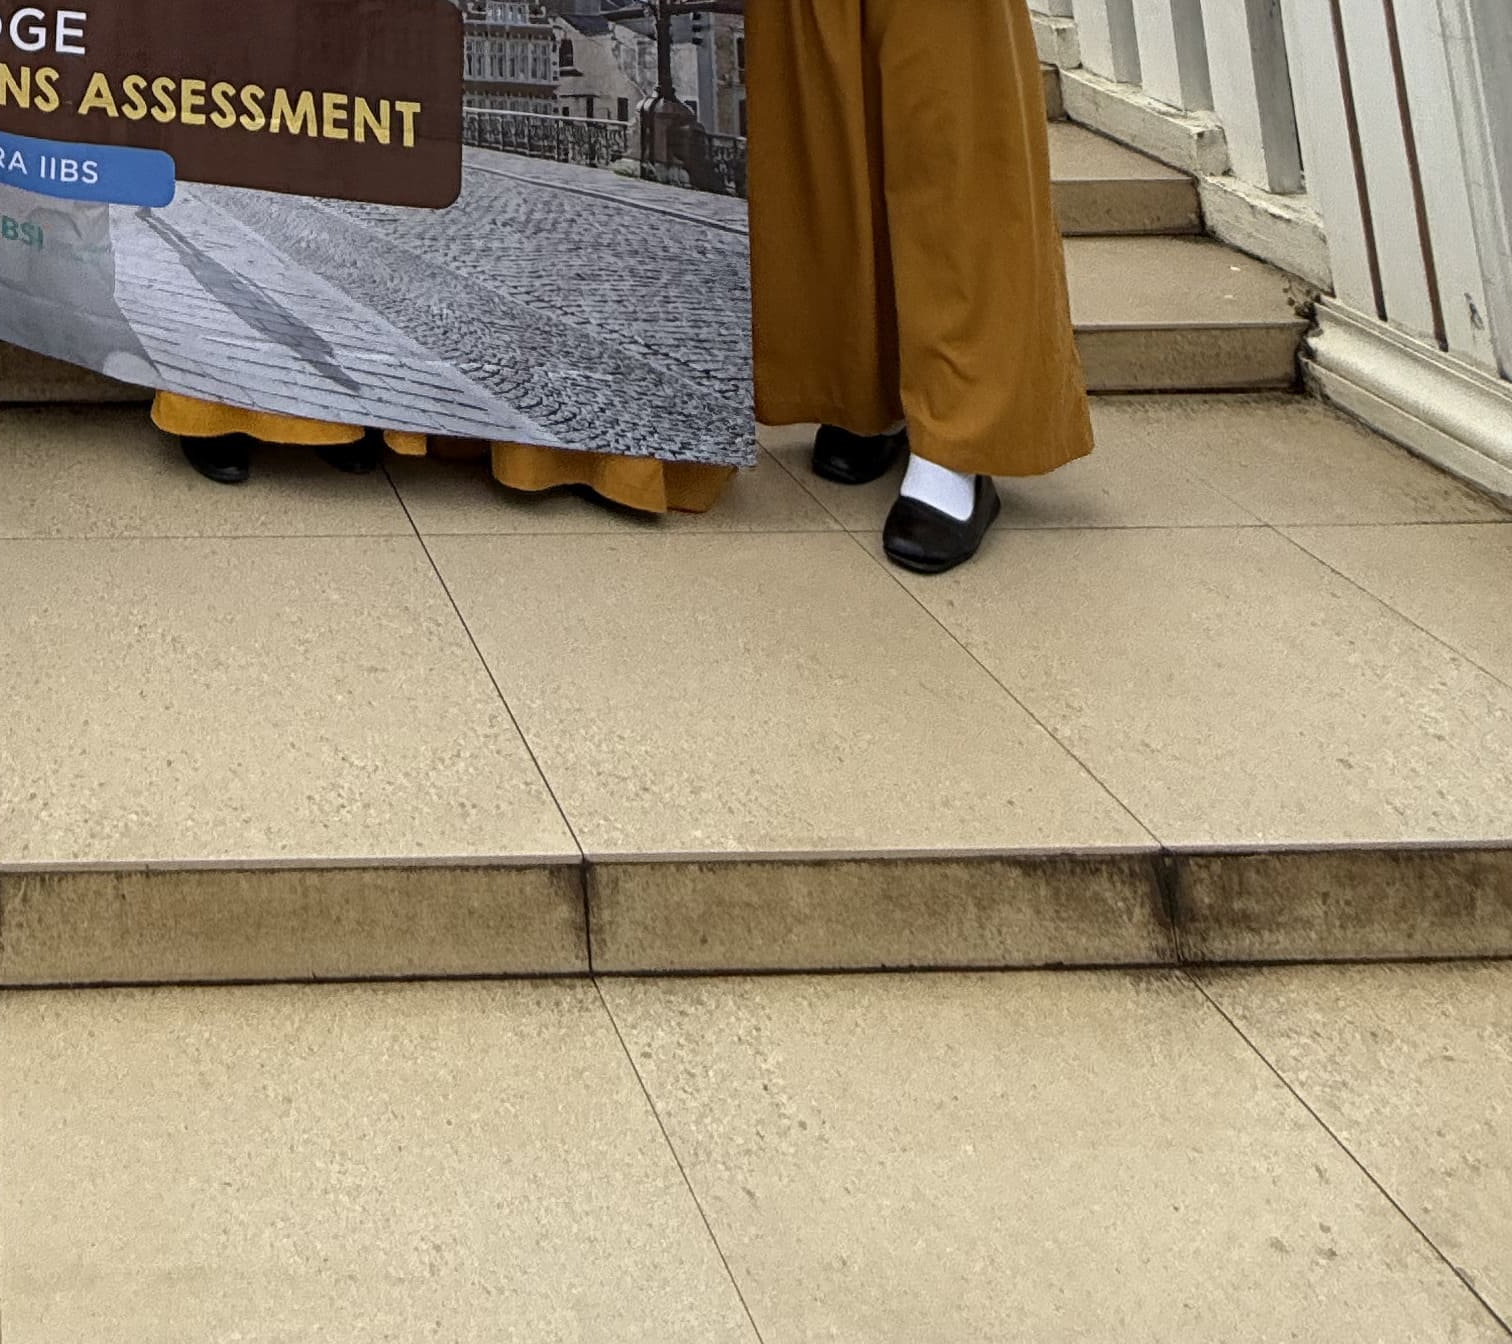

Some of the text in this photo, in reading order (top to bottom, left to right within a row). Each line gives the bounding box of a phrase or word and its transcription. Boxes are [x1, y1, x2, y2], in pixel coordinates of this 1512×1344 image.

[78, 71, 422, 148] ASSESSMENT
[39, 154, 99, 185] IIBS
[1, 215, 44, 249] BSI
